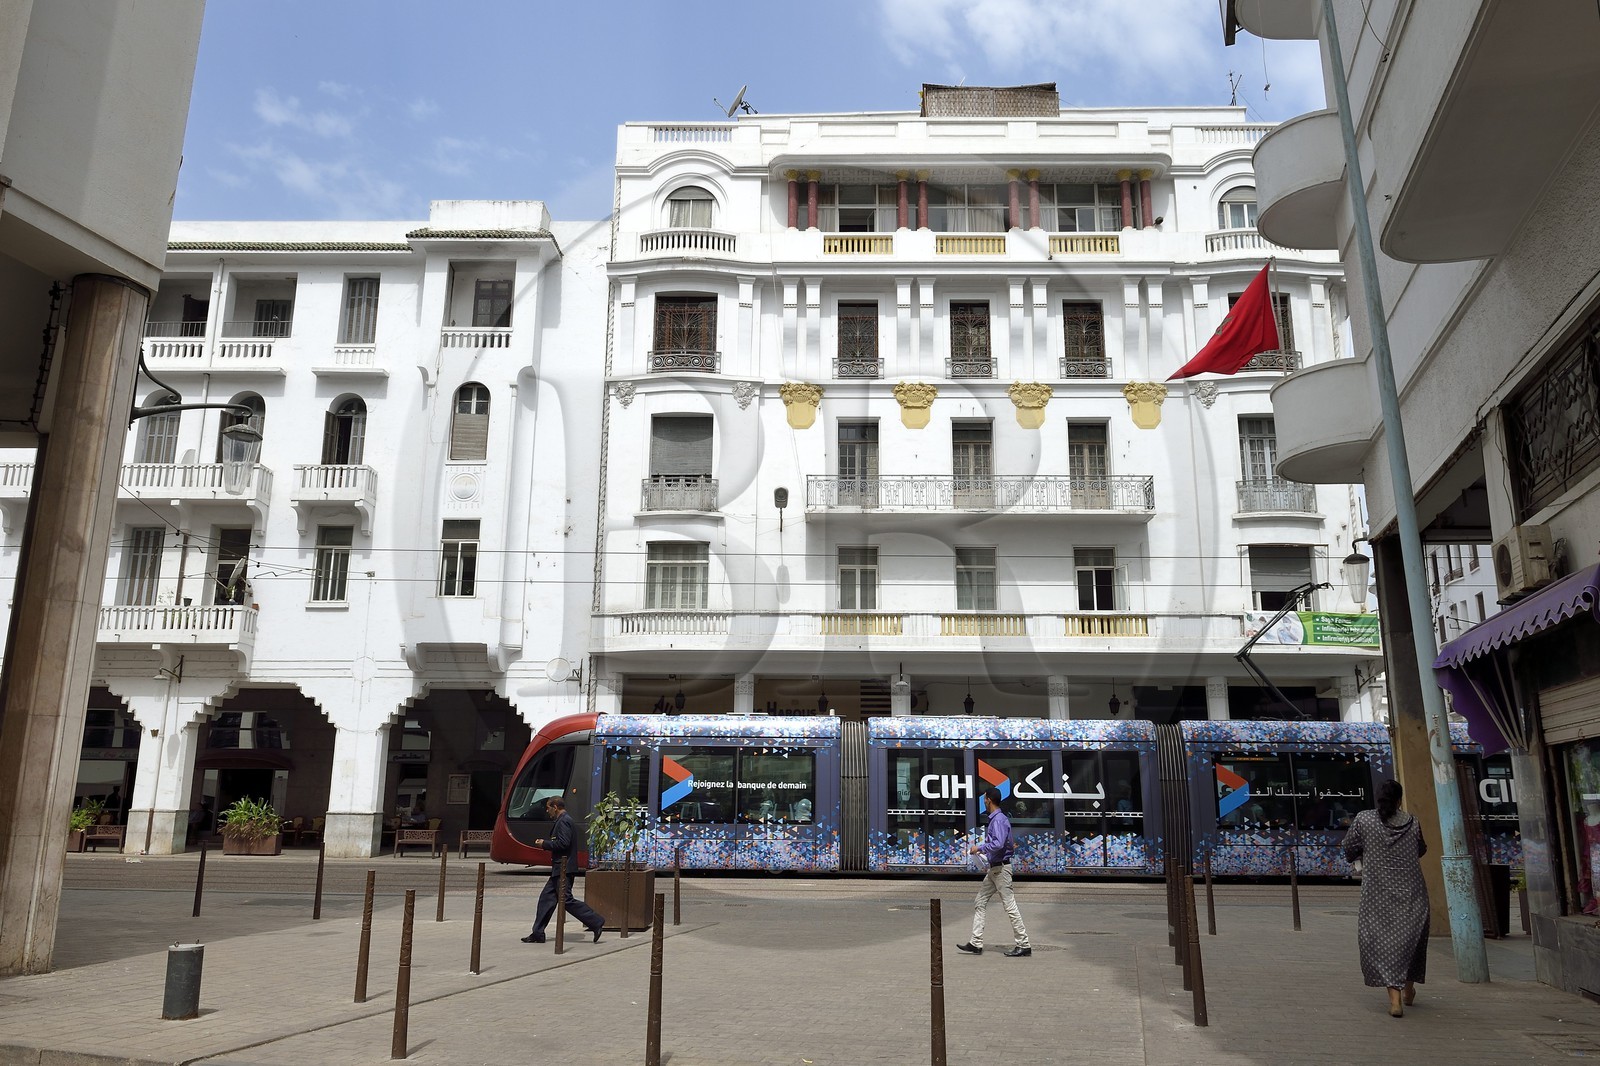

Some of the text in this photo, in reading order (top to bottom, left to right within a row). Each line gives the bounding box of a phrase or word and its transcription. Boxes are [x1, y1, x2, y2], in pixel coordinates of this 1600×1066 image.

[687, 779, 807, 791] Rejoignez la banque de demain
[919, 774, 974, 799] CIH
[1012, 766, 1106, 809] بنك
[1243, 786, 1273, 797] الغد
[1479, 778, 1517, 803] CI
